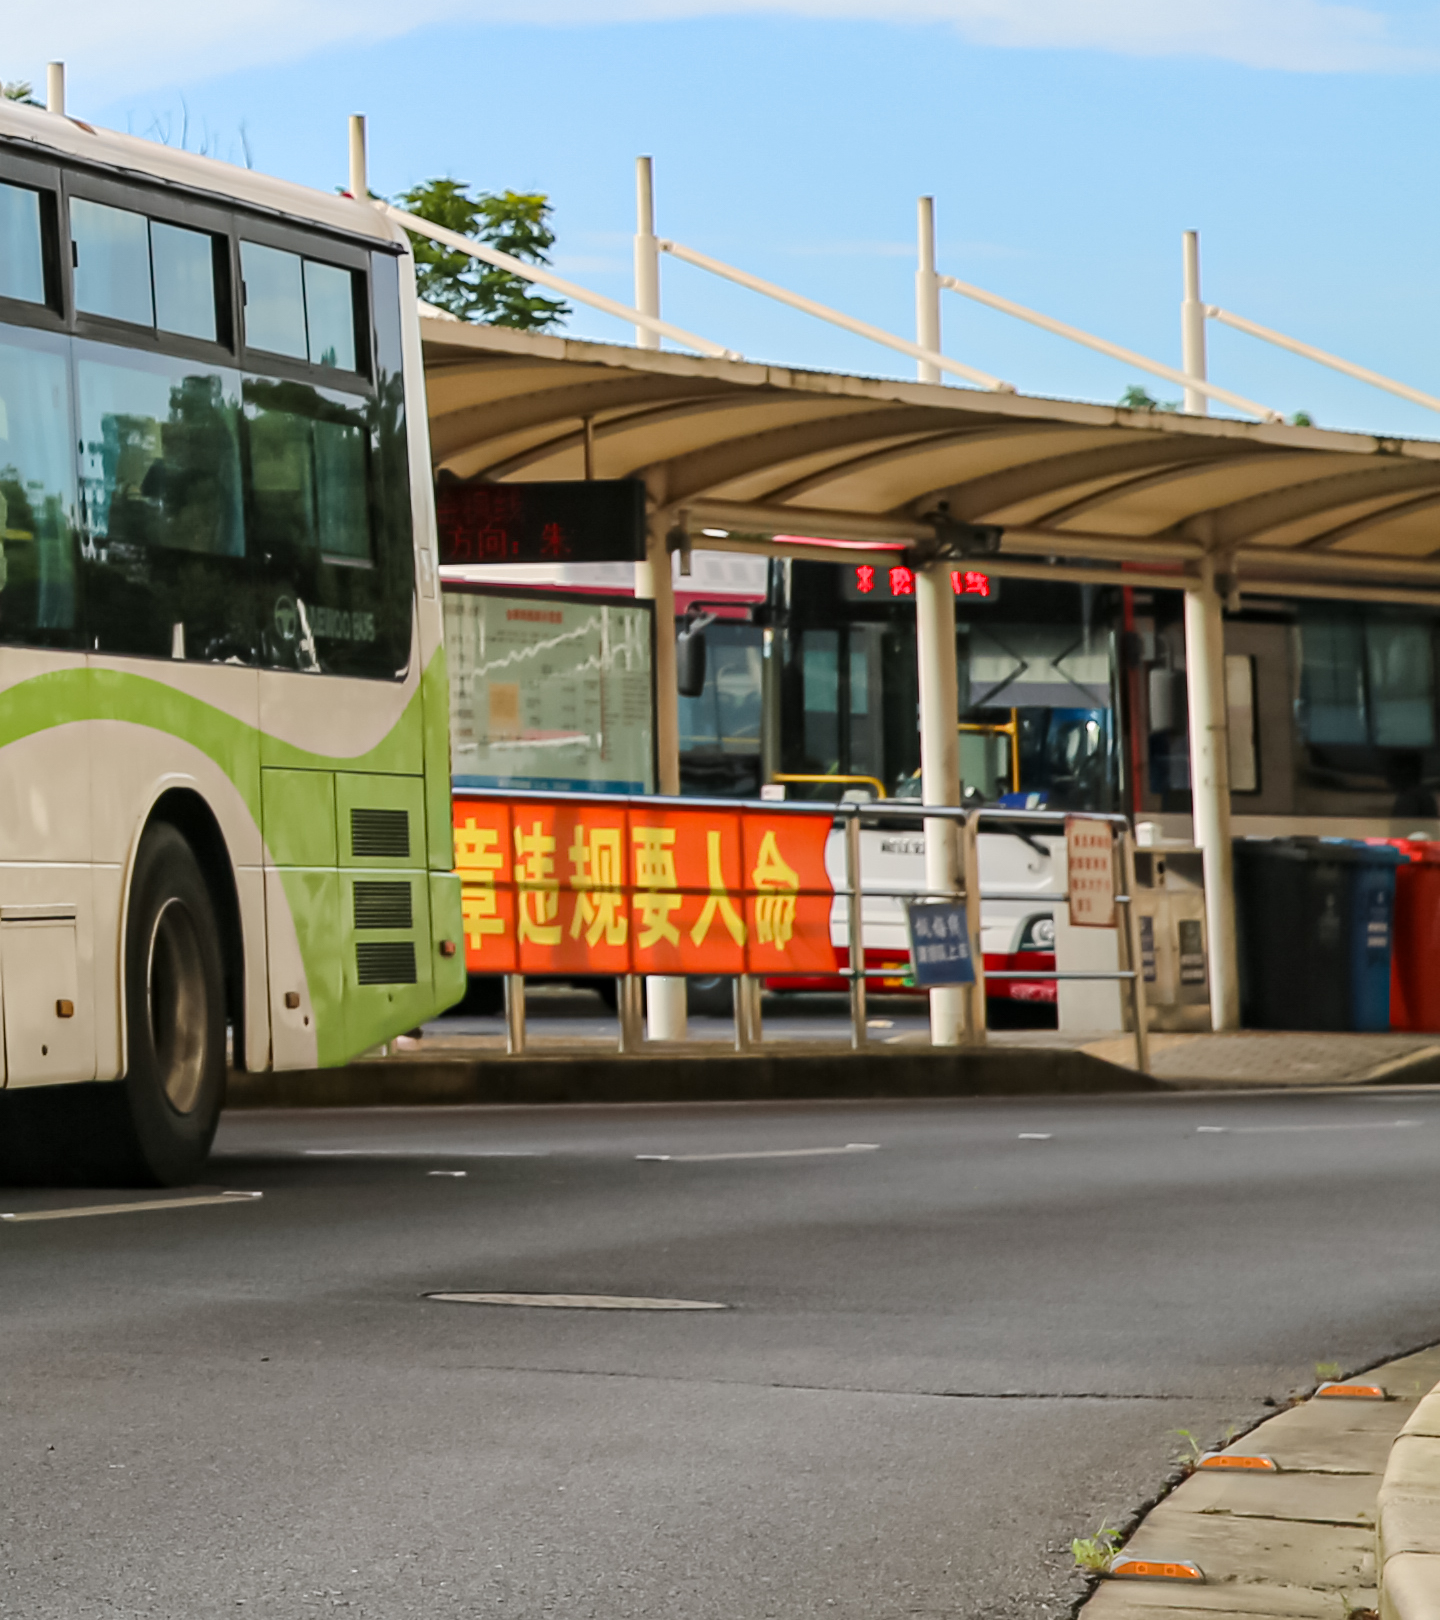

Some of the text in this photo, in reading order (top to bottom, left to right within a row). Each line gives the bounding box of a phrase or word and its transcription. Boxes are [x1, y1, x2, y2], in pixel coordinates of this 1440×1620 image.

[299, 602, 351, 639] AEWOO
[453, 817, 800, 951] 章违规要人命
